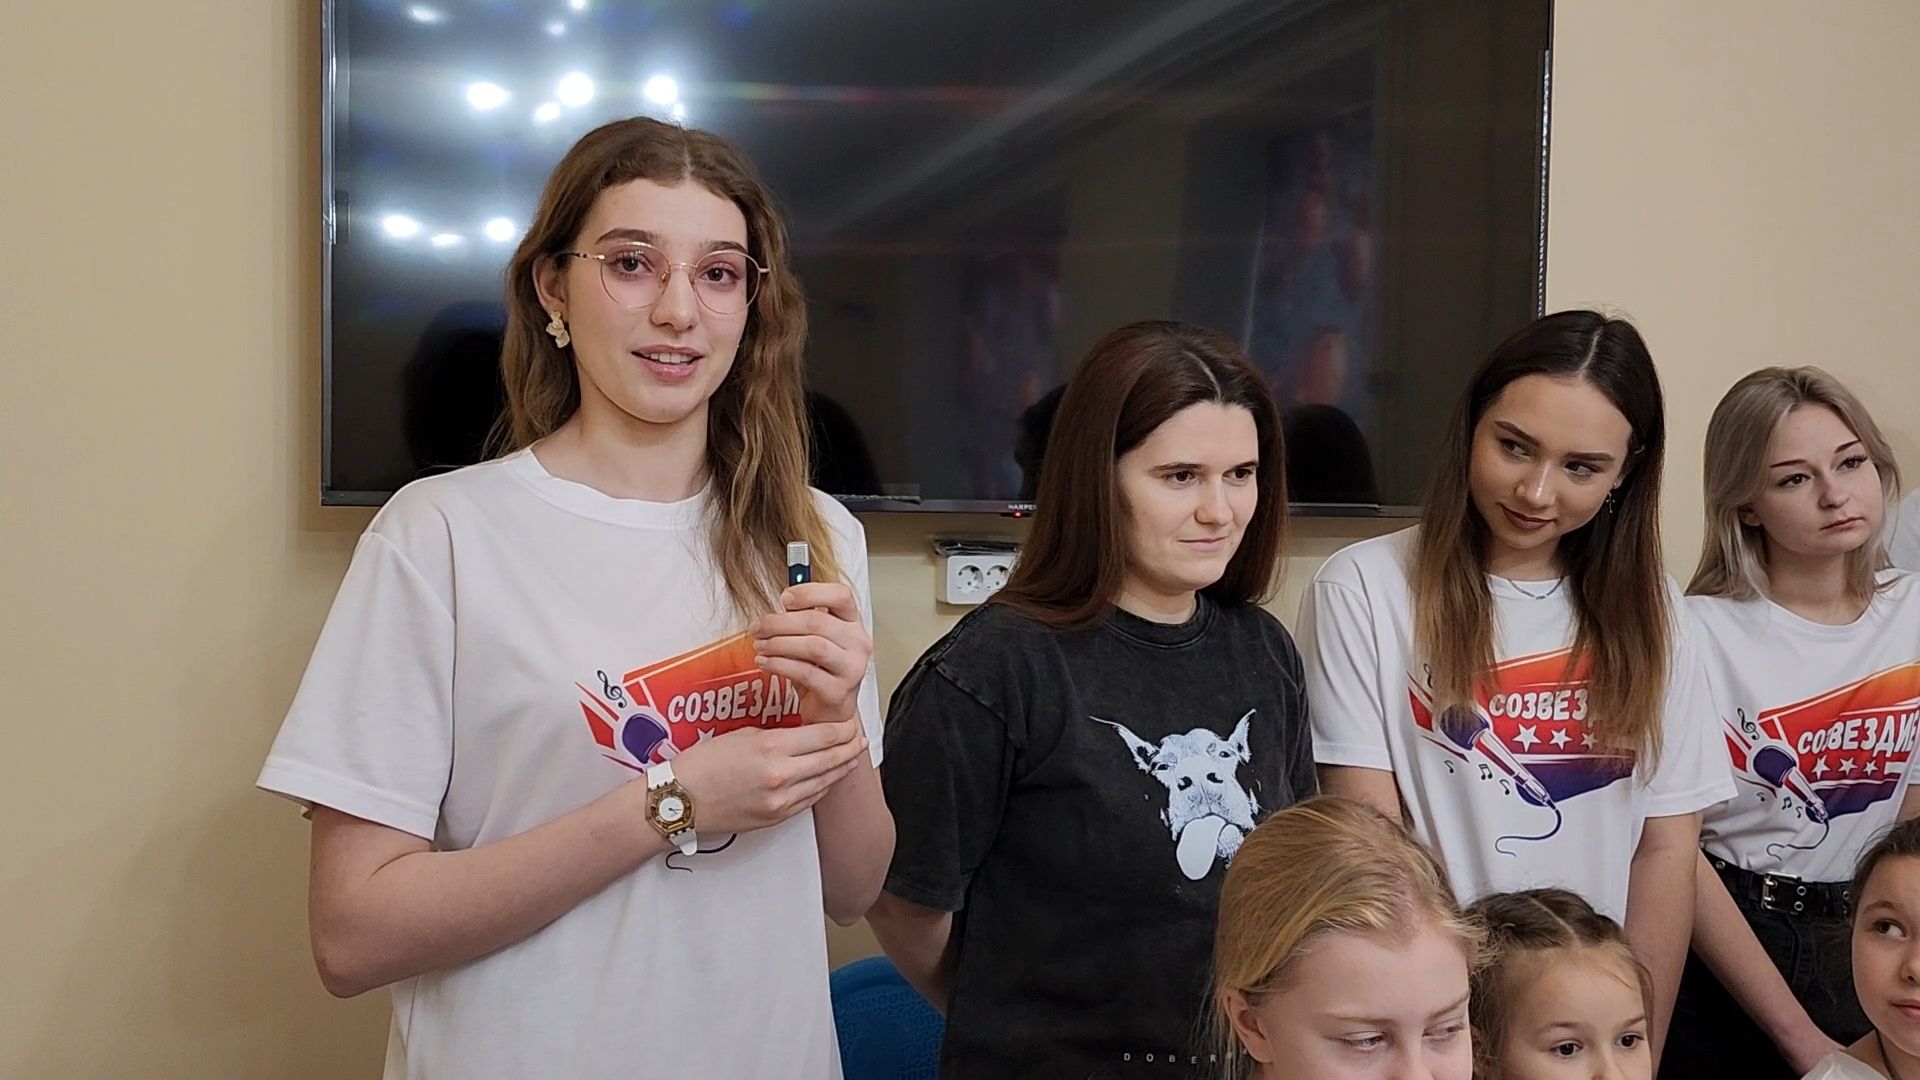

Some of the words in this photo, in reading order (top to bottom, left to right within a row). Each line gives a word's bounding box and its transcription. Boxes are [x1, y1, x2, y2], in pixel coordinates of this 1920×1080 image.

[667, 674, 801, 725] СОЗВЕЗДИ
[1488, 688, 1590, 721] СОЗВЕЗ
[1123, 1052, 1232, 1064] DOBER
